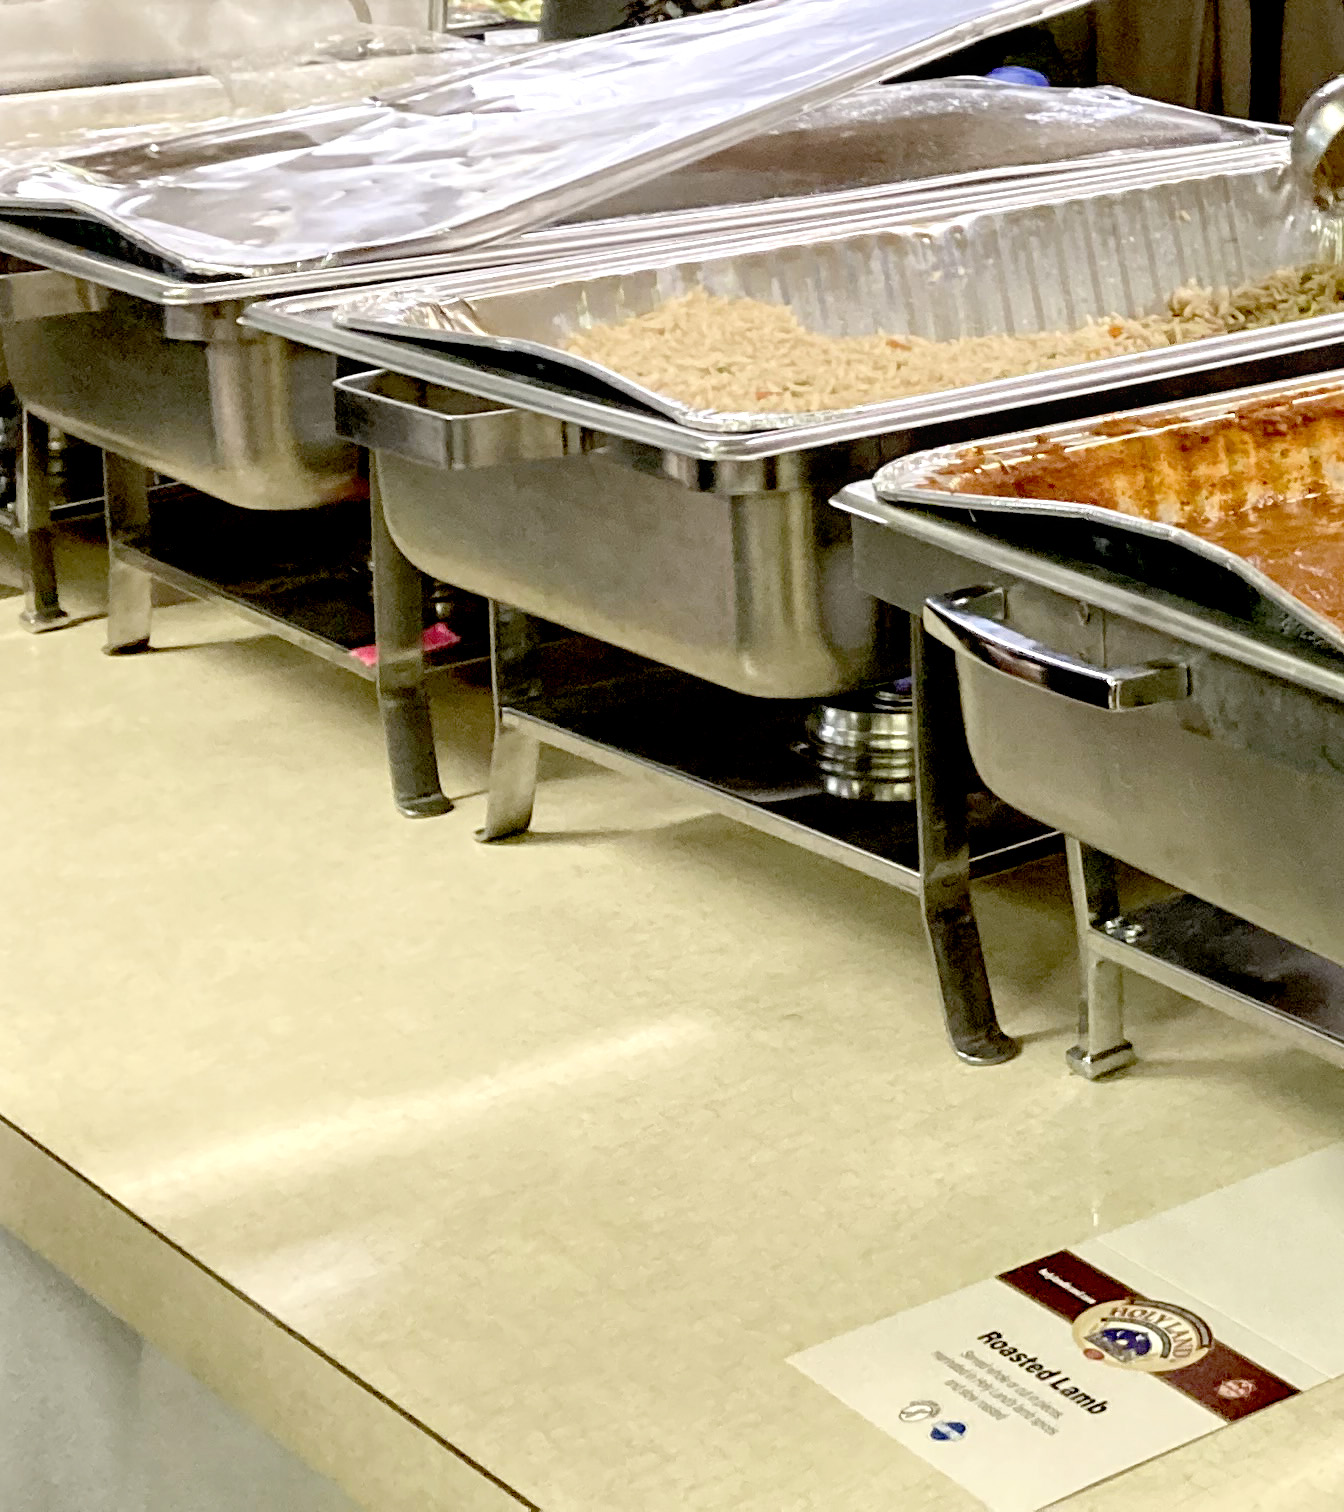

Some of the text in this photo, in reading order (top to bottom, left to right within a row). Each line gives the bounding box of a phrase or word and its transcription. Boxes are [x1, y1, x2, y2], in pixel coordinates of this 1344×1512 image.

[1109, 1306, 1194, 1359] HOLY LAND
[977, 1331, 1062, 1382] Roasted
[1049, 1376, 1109, 1415] Lamb
